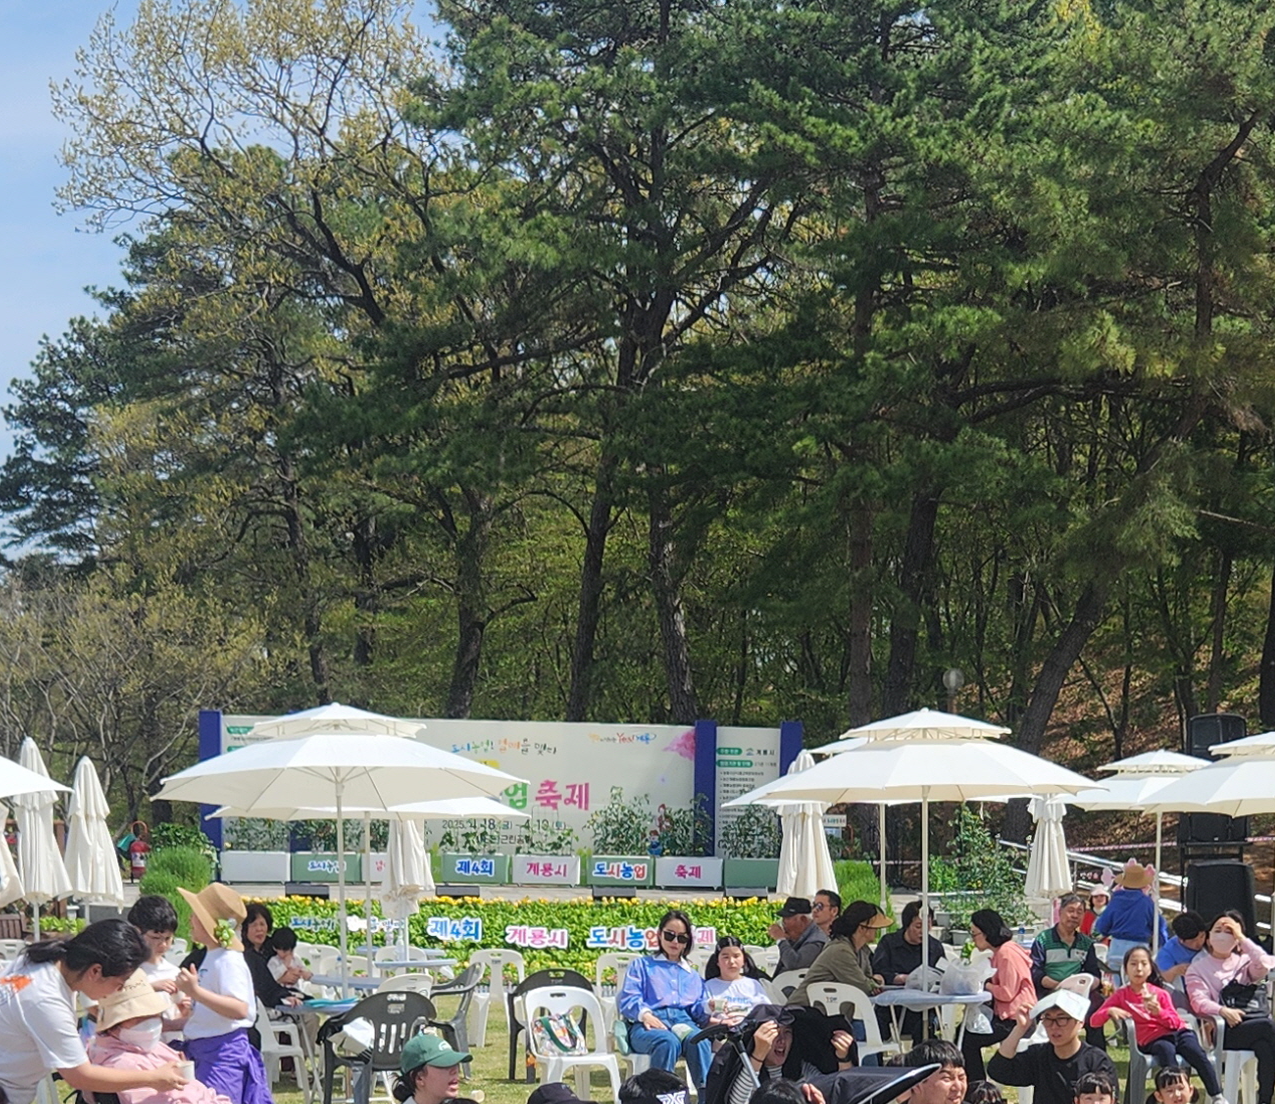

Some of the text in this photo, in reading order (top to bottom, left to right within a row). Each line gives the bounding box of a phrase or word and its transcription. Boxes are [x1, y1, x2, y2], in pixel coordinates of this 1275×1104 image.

[535, 779, 590, 811] 축제
[456, 858, 702, 881] 제4회 계룡시 도시농업 축제
[428, 918, 481, 940] 제4회
[507, 926, 568, 949] 계룡시
